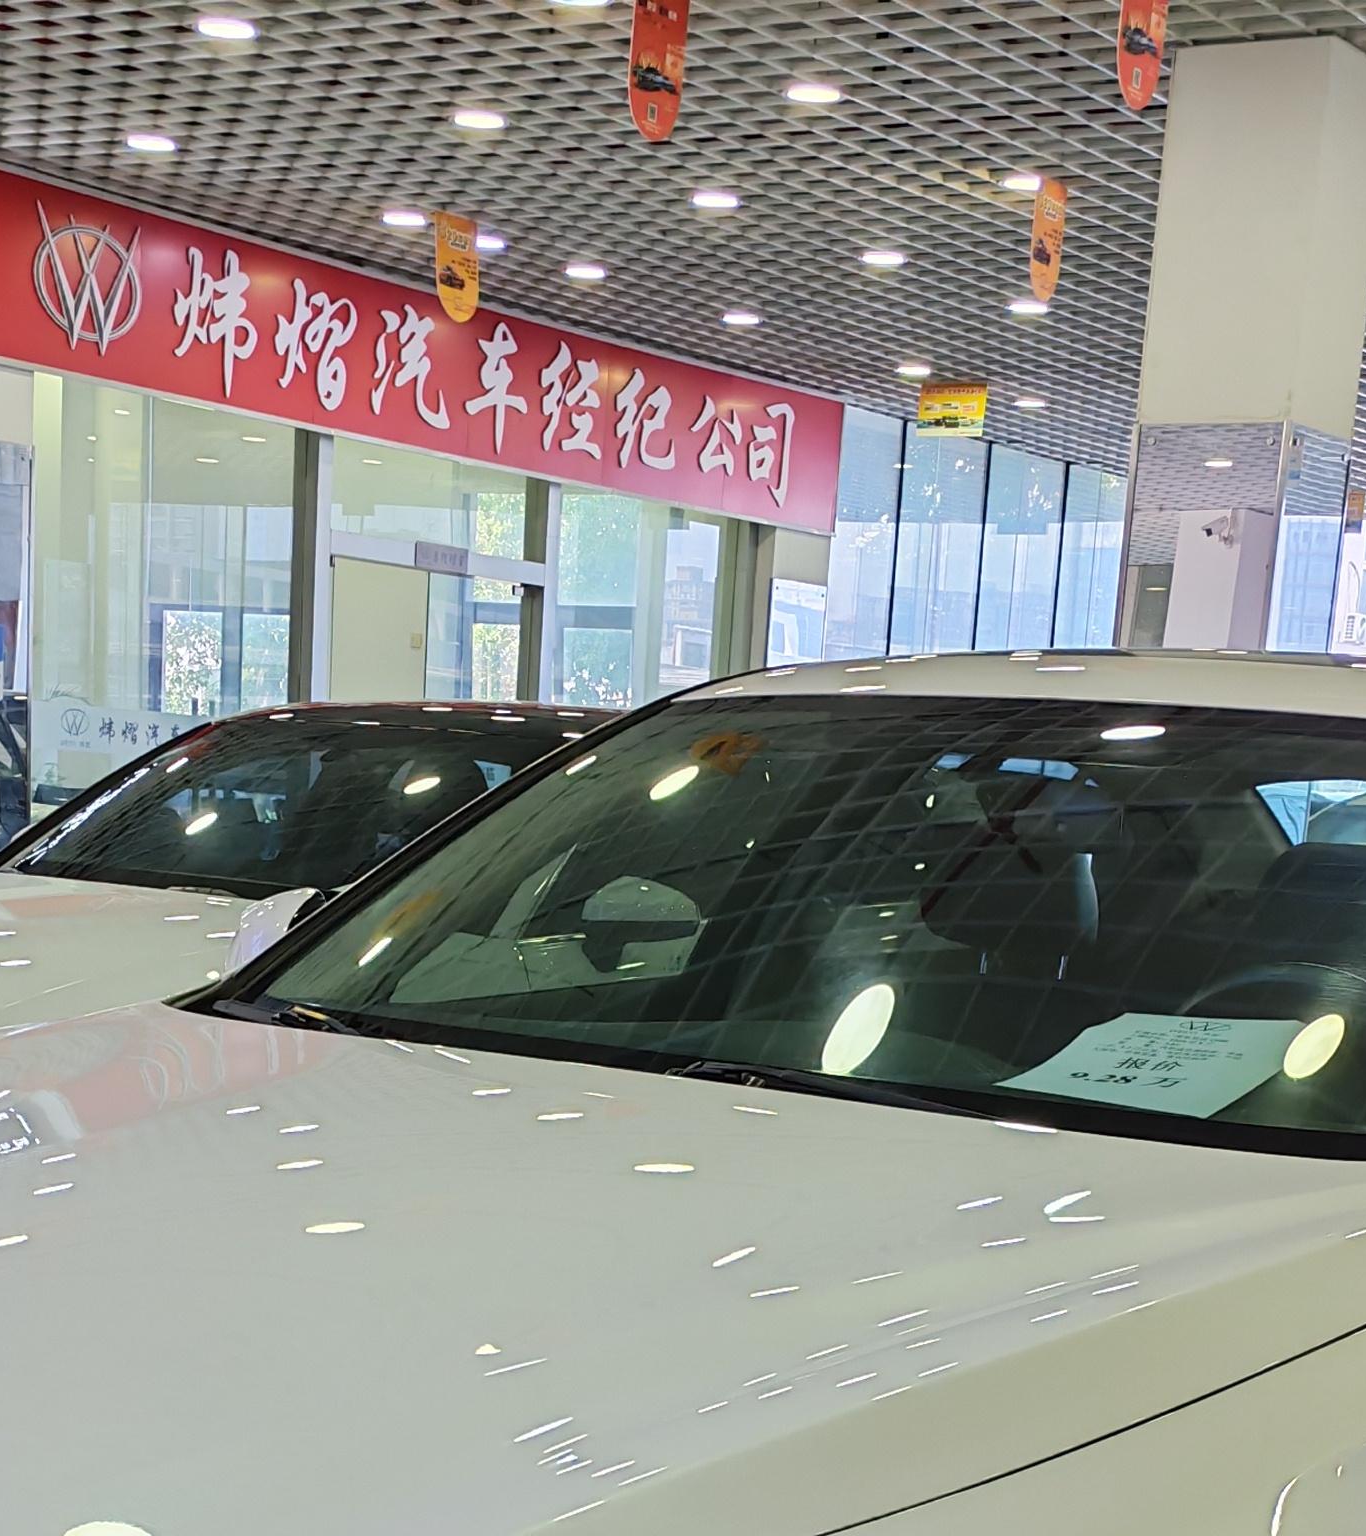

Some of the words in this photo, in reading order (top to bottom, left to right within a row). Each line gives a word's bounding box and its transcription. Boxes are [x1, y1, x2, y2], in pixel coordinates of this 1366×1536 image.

[173, 244, 795, 508] 炜熠汽车经纪公司
